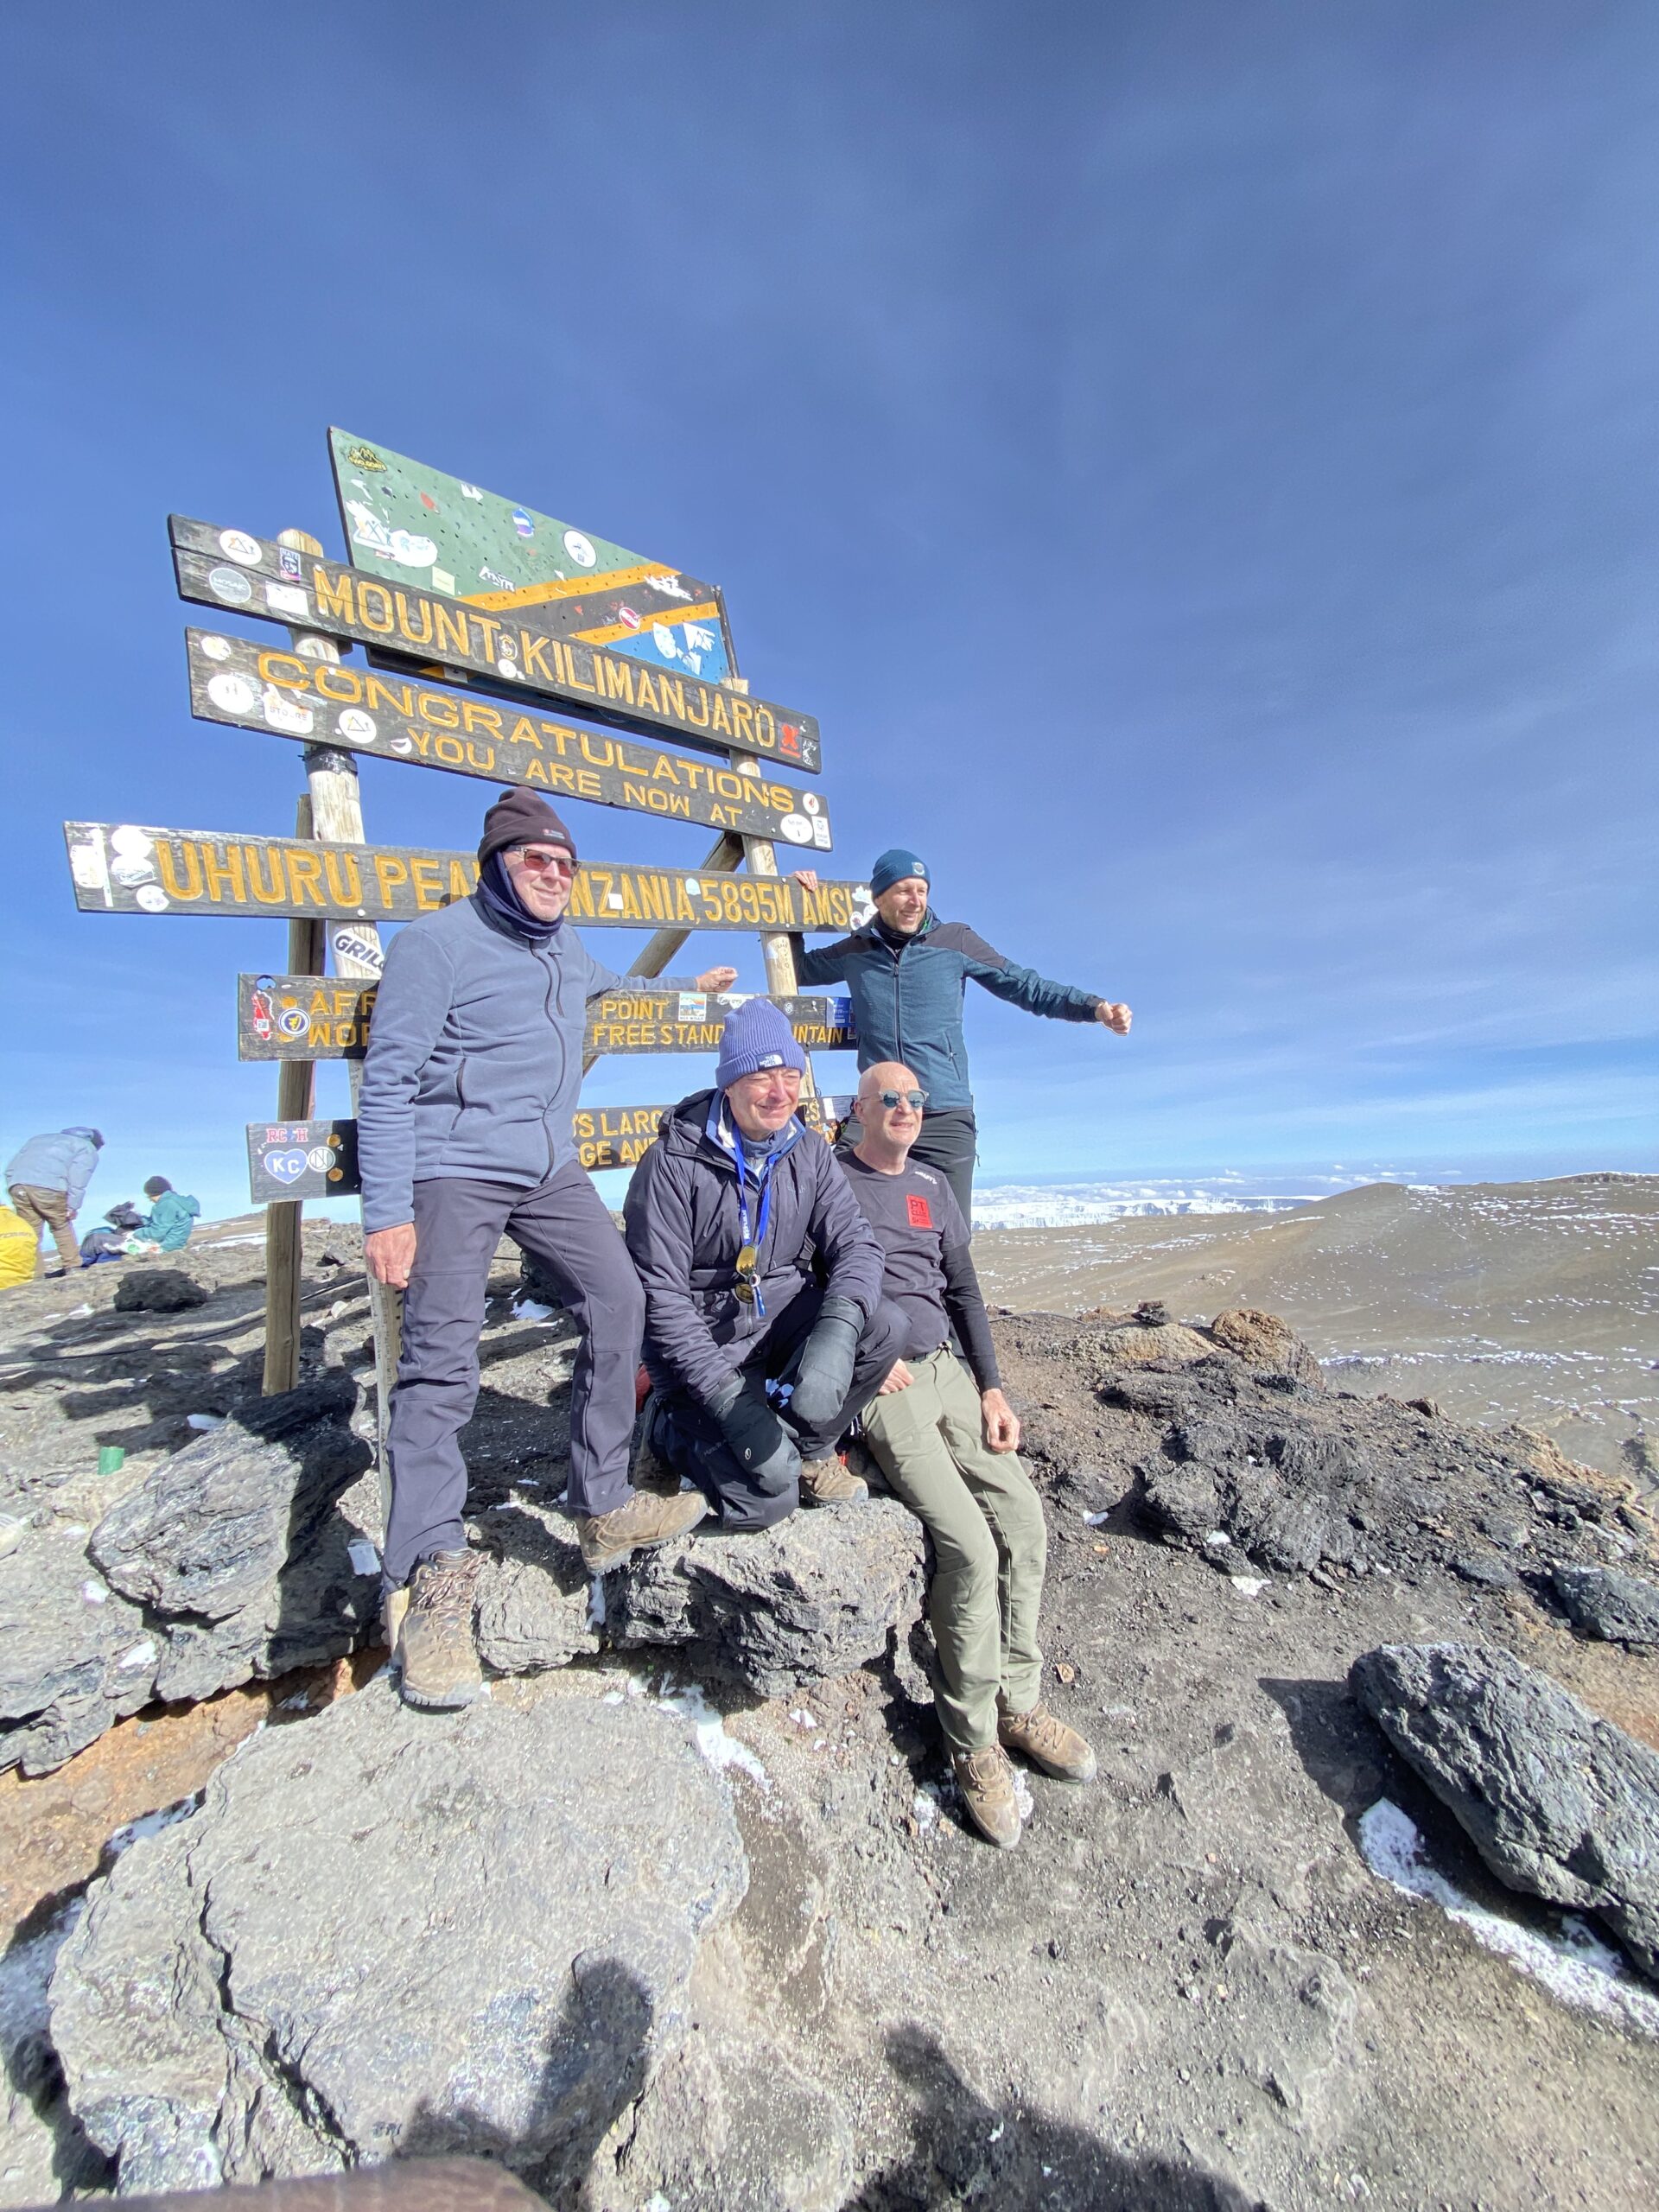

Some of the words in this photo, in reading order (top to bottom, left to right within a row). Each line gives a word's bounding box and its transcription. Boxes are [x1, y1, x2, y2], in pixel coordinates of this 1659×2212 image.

[313, 565, 501, 664] MOUNT
[520, 630, 775, 747] KILIMANJARO
[258, 652, 794, 812] CONGRATULATIONS
[408, 728, 494, 770] YOU
[525, 759, 601, 797] ARE
[623, 781, 690, 817] NOW
[710, 803, 742, 826] AT
[155, 840, 364, 907] UHURU
[373, 854, 480, 911] PEA
[563, 868, 700, 925] NZANIA,
[591, 1022, 657, 1046] FREE
[601, 998, 670, 1020] POINT
[272, 1157, 300, 1174] KC
[620, 1136, 658, 1163] AN
